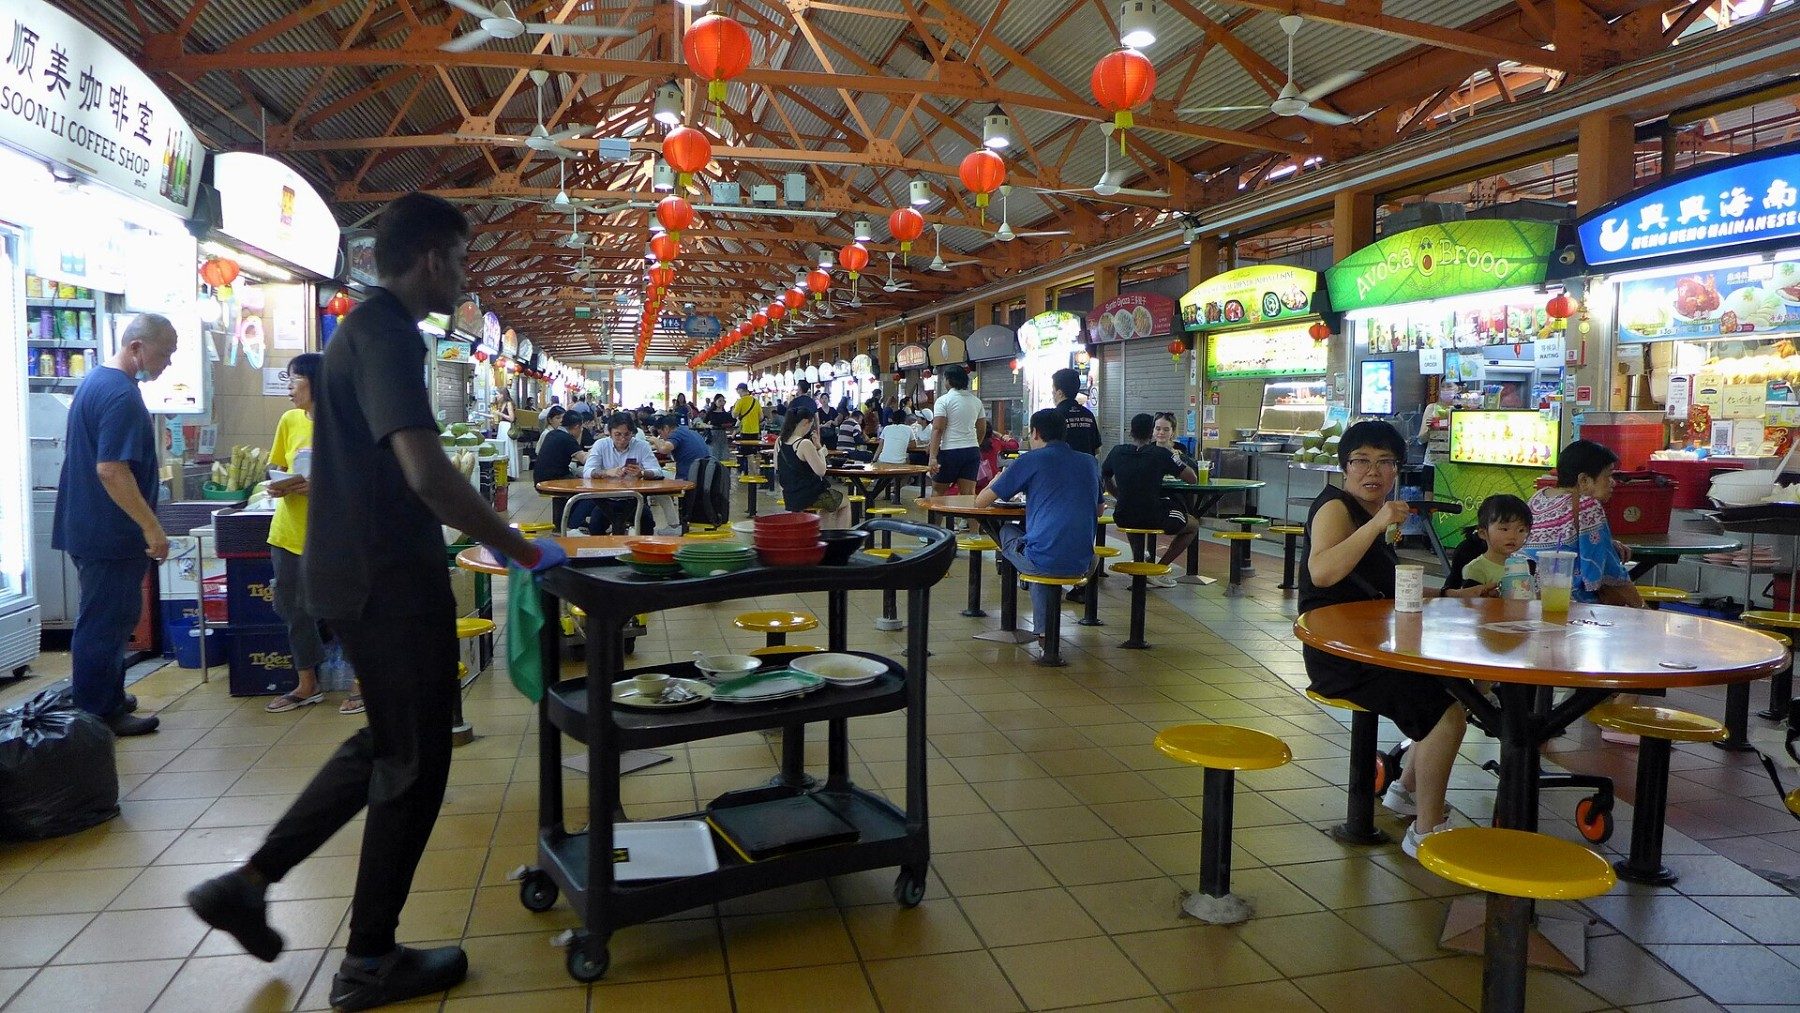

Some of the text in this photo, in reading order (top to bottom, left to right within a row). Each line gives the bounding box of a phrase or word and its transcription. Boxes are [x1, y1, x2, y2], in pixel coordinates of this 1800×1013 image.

[6, 19, 154, 147] 顺美咖啡室
[1, 86, 150, 177] SOON LI COFFEE SHOP
[1631, 210, 1797, 250] HENG HENG HAINANESE
[1439, 239, 1509, 279] Brooo
[247, 583, 275, 602] Tig
[248, 652, 293, 670] Tiger
